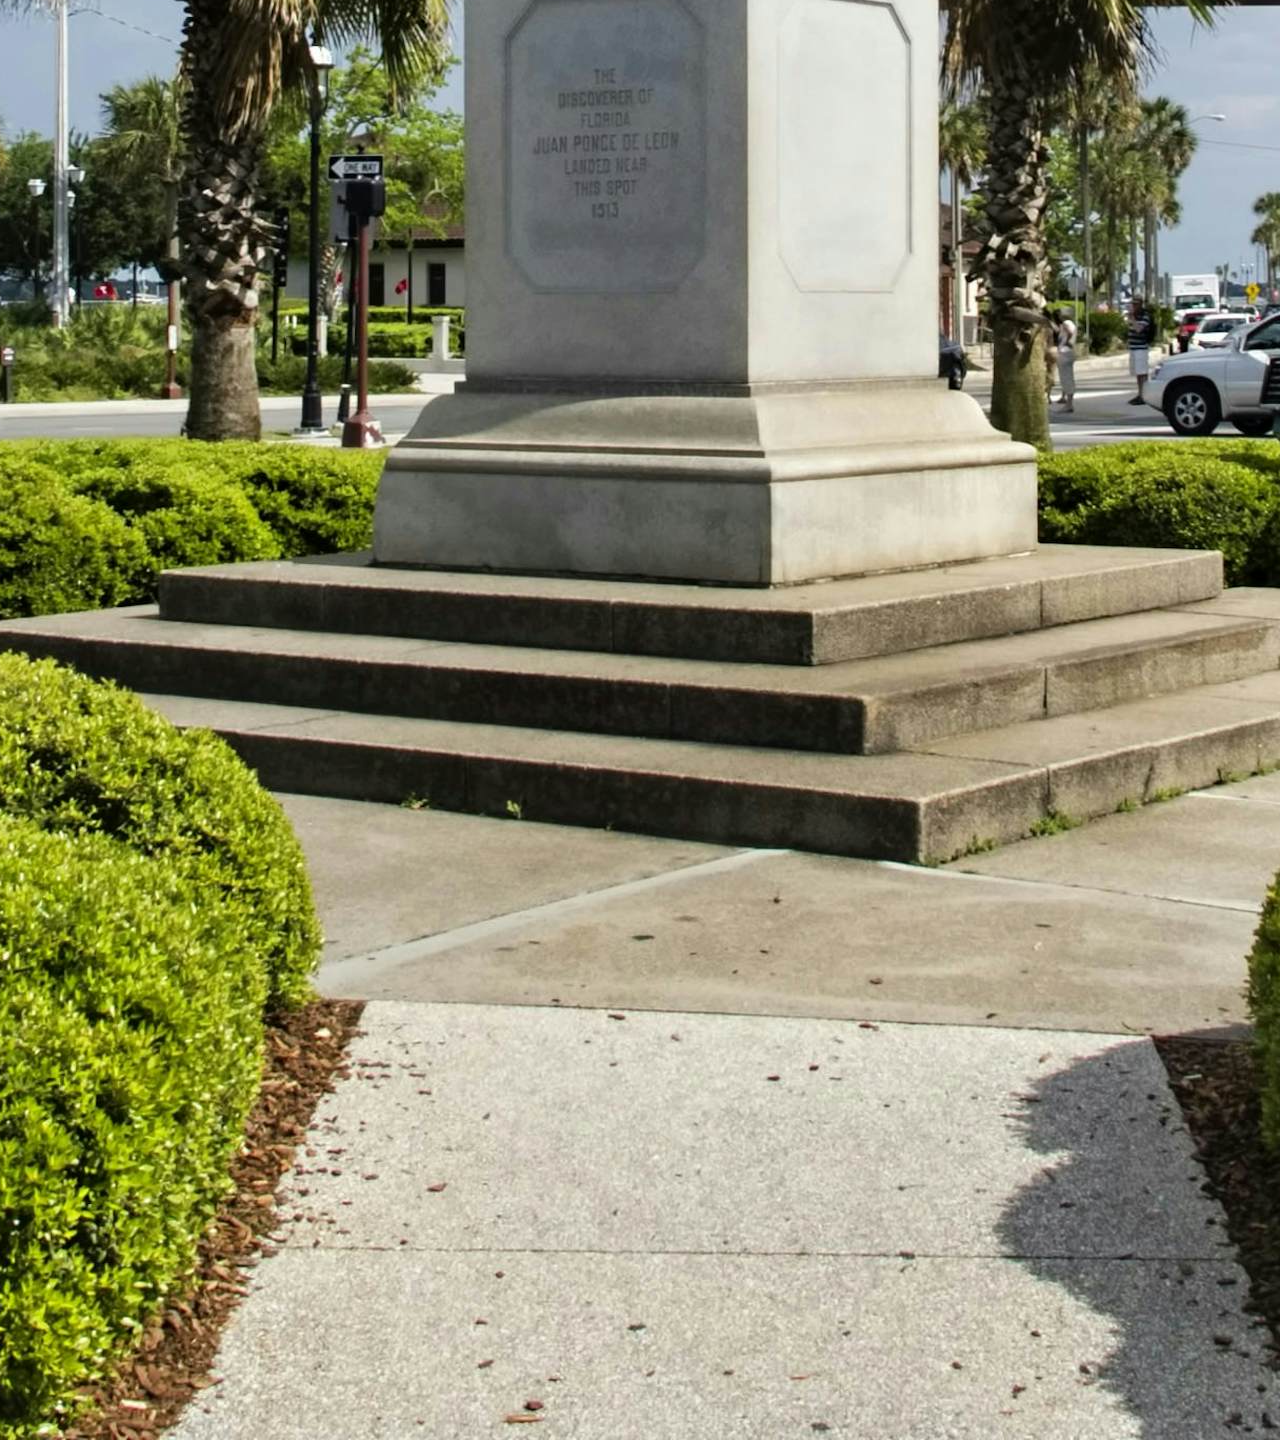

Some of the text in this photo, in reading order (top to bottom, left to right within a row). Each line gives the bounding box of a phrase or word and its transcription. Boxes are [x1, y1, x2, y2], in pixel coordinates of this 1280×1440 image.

[594, 68, 617, 84] THE
[558, 88, 654, 109] DISCOVERER OF
[580, 112, 632, 128] FLORIDA
[533, 131, 680, 155] JUAN PONCE DE LEON
[344, 162, 377, 173] ONE WAY
[564, 157, 648, 175] LANDED NEAR
[573, 179, 639, 197] THIS SPOT
[591, 201, 619, 219] 1513
